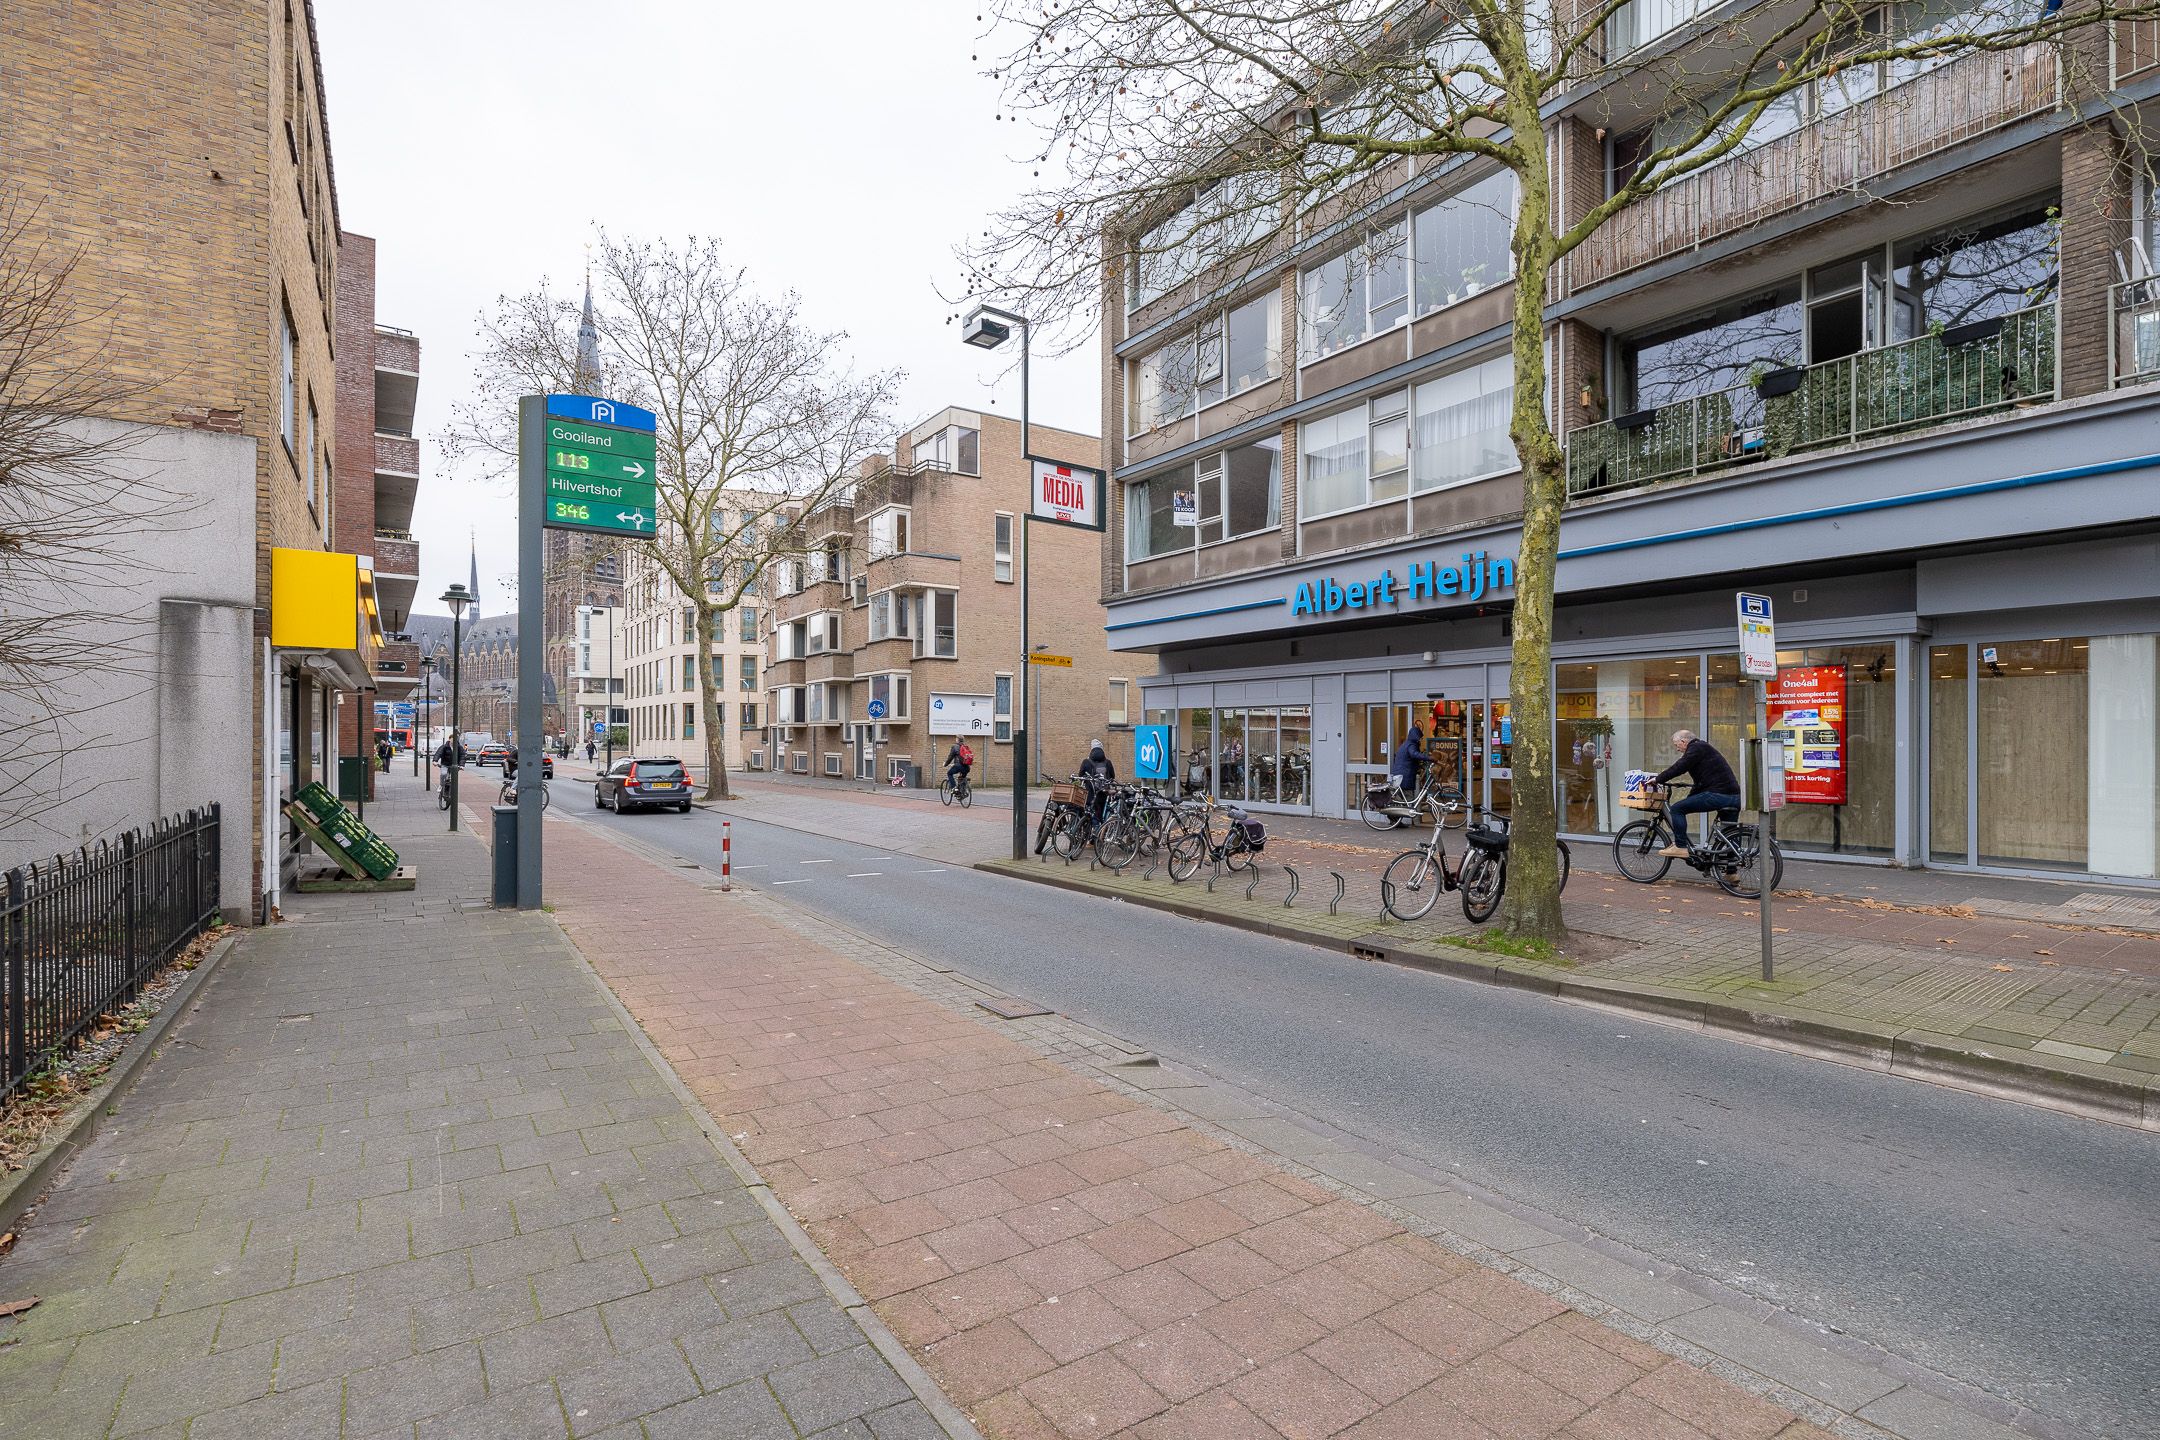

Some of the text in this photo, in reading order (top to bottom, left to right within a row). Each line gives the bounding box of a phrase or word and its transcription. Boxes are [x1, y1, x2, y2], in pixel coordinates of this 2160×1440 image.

[552, 427, 612, 447] Gooiland
[556, 452, 590, 470] 113
[552, 477, 622, 498] Hilvertshof
[1043, 476, 1084, 511] MEDIA
[556, 502, 590, 520] 346
[1292, 550, 1515, 617] Albert Heijn
[1783, 679, 1818, 688] One4all
[1807, 775, 1831, 783] korting
